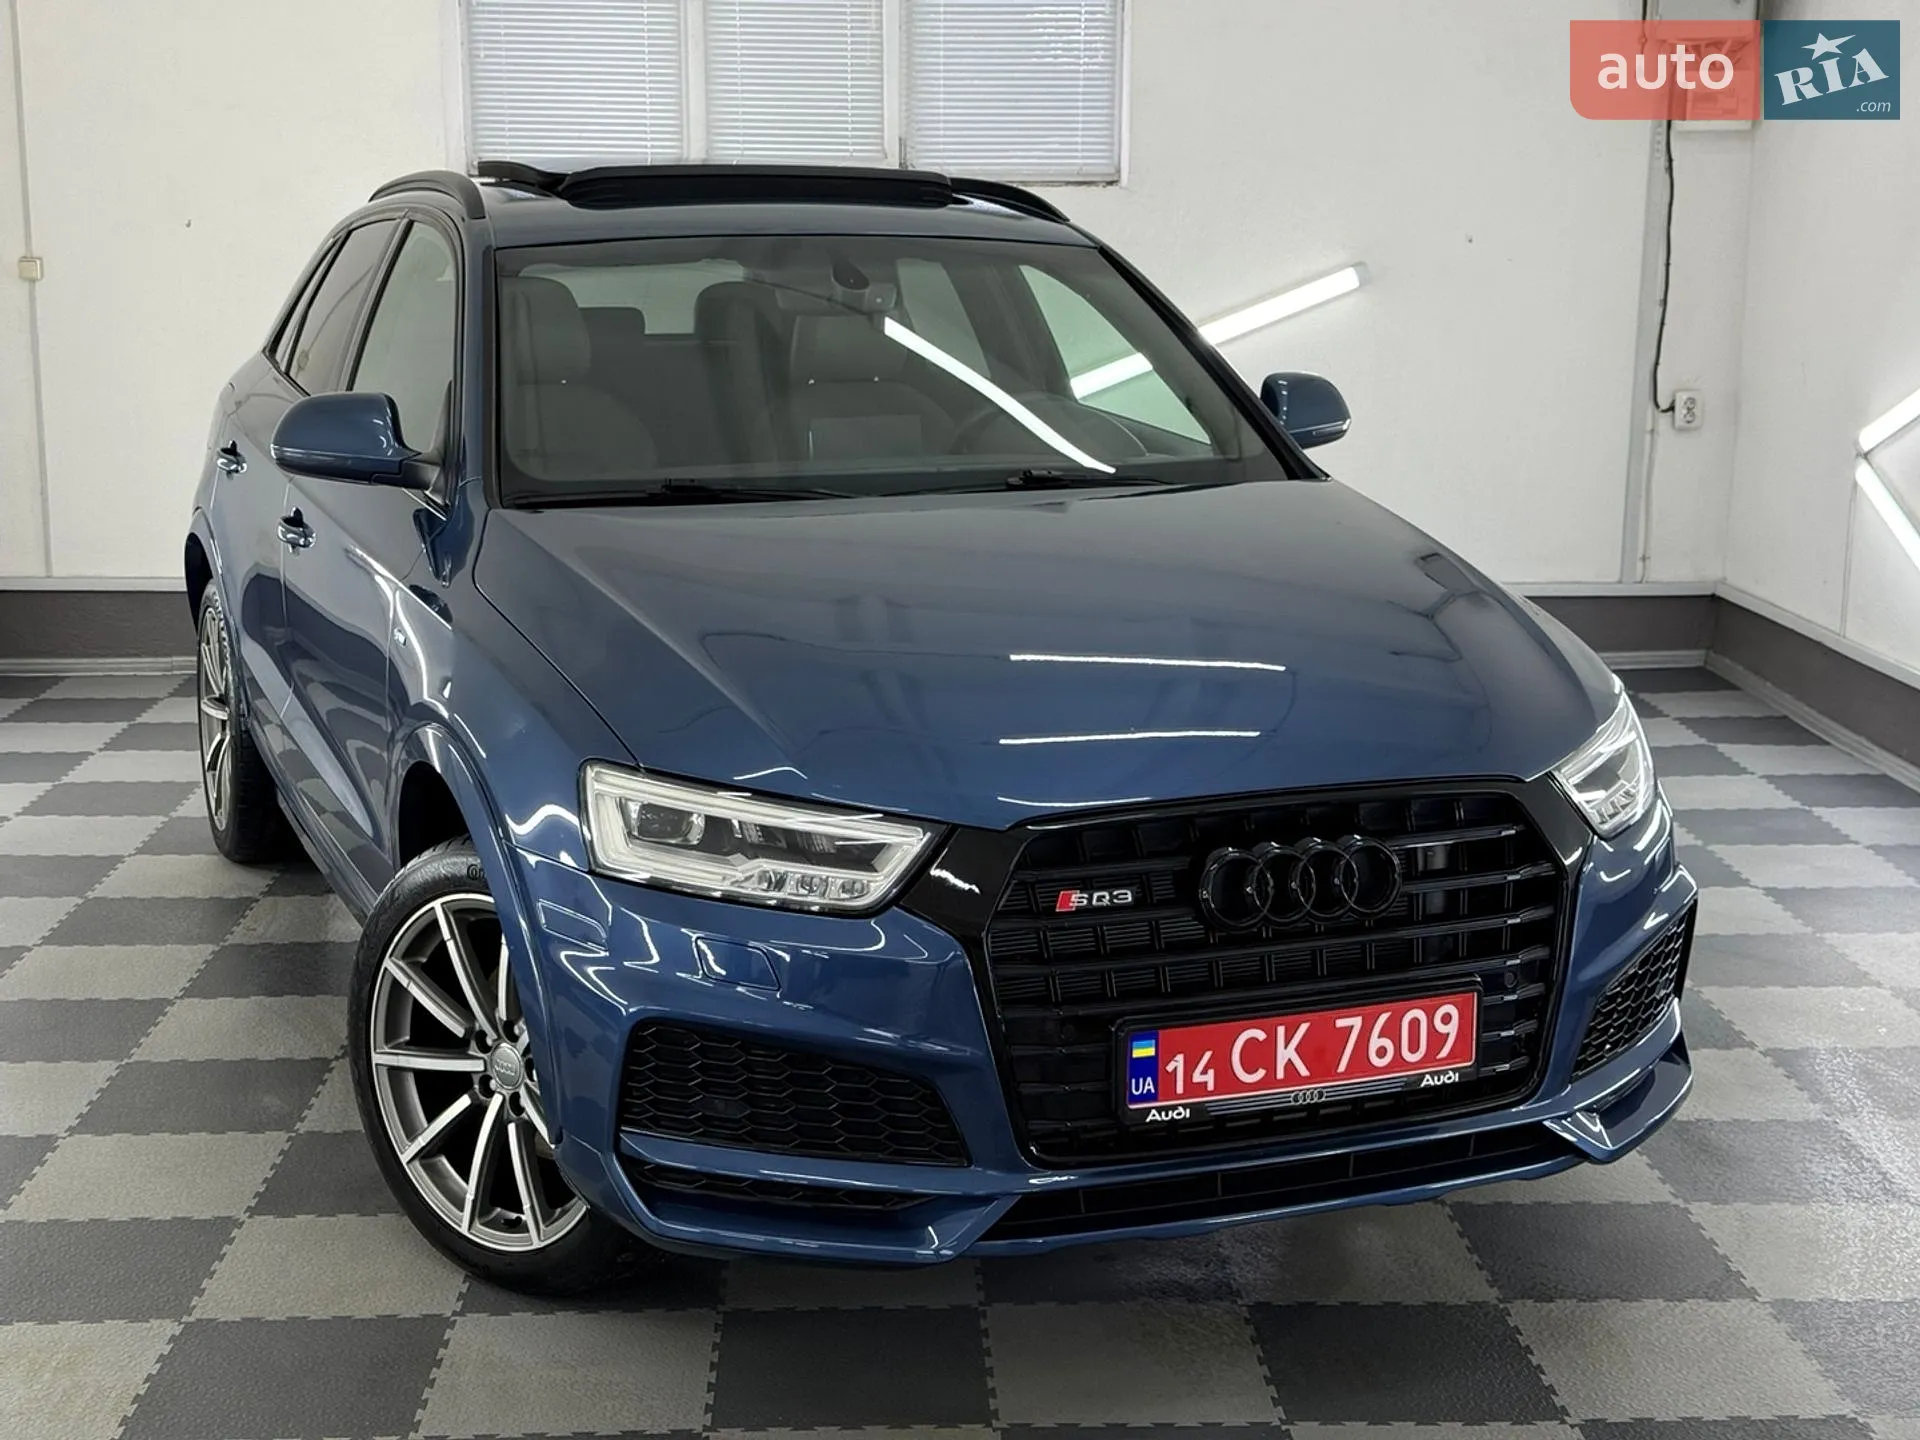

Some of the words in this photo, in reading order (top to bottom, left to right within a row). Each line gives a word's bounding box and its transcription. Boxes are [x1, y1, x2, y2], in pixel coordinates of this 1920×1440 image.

[1066, 889, 1132, 907] SQ3
[1165, 1051, 1215, 1094] 14
[1230, 1022, 1310, 1084] CK
[1334, 1003, 1459, 1074] 7609
[1131, 1076, 1156, 1096] UA
[1420, 1071, 1459, 1088] Audi
[1145, 1107, 1191, 1123] Audi
